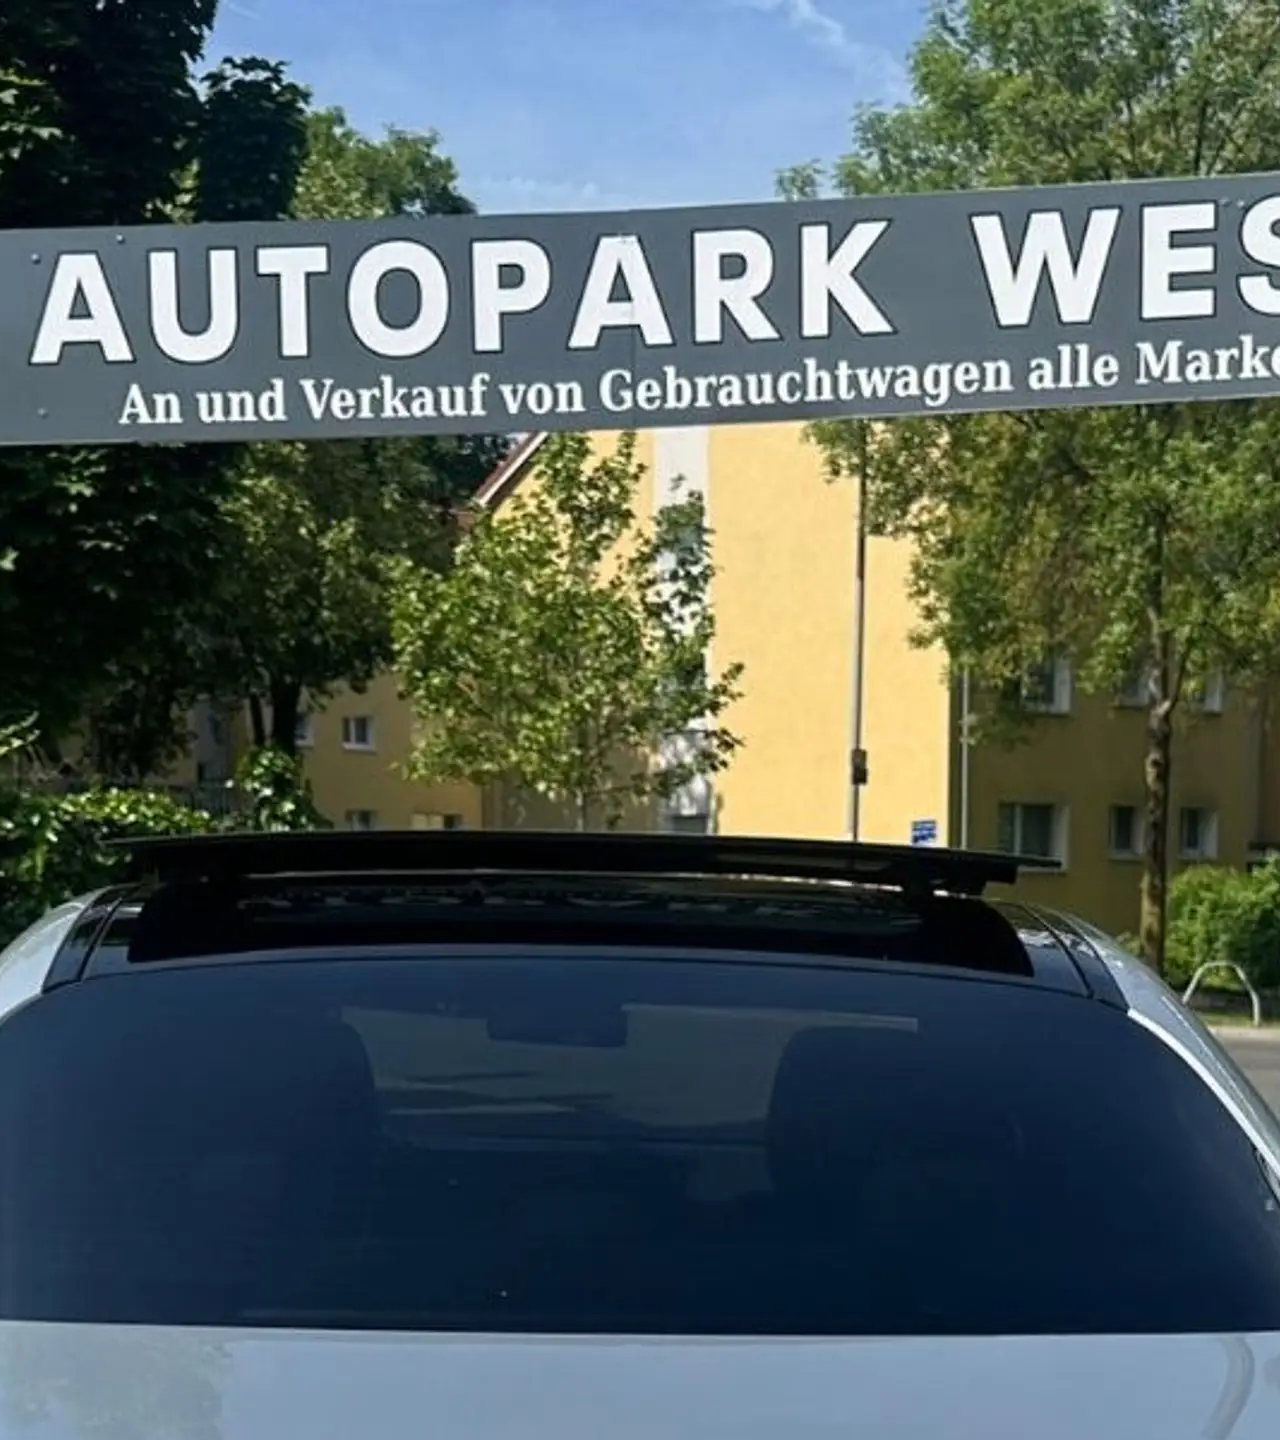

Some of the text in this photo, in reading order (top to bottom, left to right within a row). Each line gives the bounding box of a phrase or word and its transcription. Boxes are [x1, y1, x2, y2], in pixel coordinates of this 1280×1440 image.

[29, 219, 897, 365] AUTOPARK
[118, 383, 183, 425] An
[195, 379, 287, 424] und
[300, 371, 490, 420] Verkauf
[499, 382, 586, 416] von
[599, 357, 1014, 413] Gebrauchtwagen
[1028, 343, 1119, 391] alle
